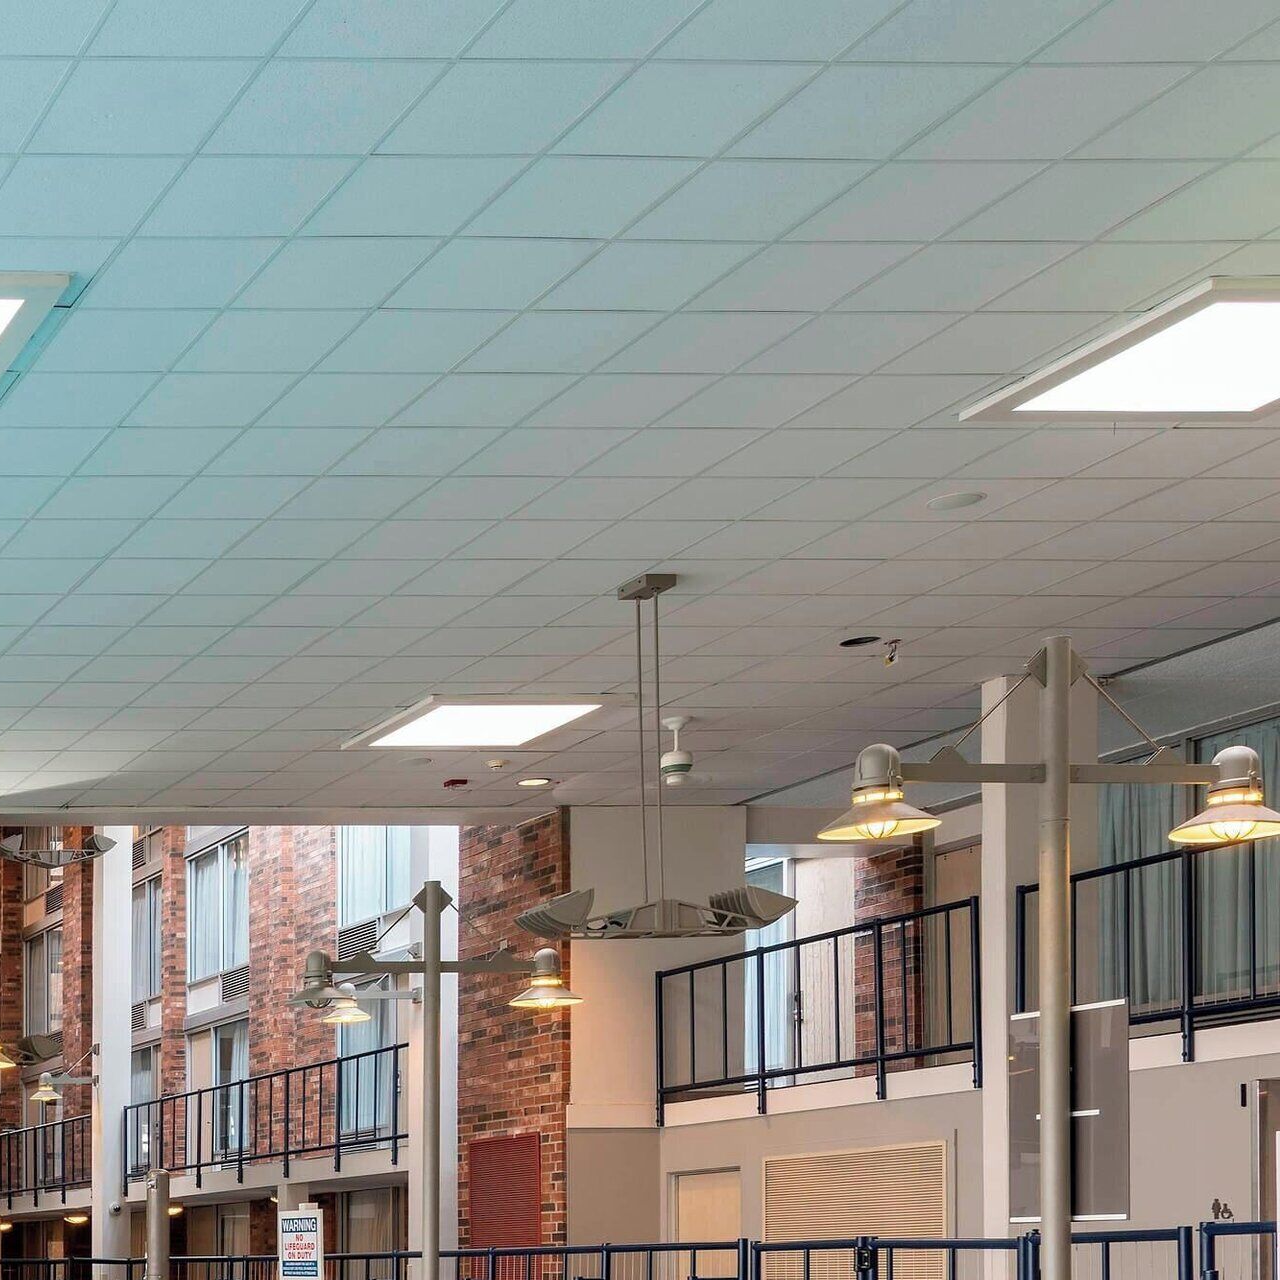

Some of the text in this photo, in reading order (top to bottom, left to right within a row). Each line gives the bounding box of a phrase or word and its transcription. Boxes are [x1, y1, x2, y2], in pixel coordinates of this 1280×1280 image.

[282, 1218, 316, 1231] WARNING
[295, 1233, 304, 1241] NO
[285, 1242, 315, 1251] LIFEGUARD
[288, 1251, 312, 1259] ON DUTY
